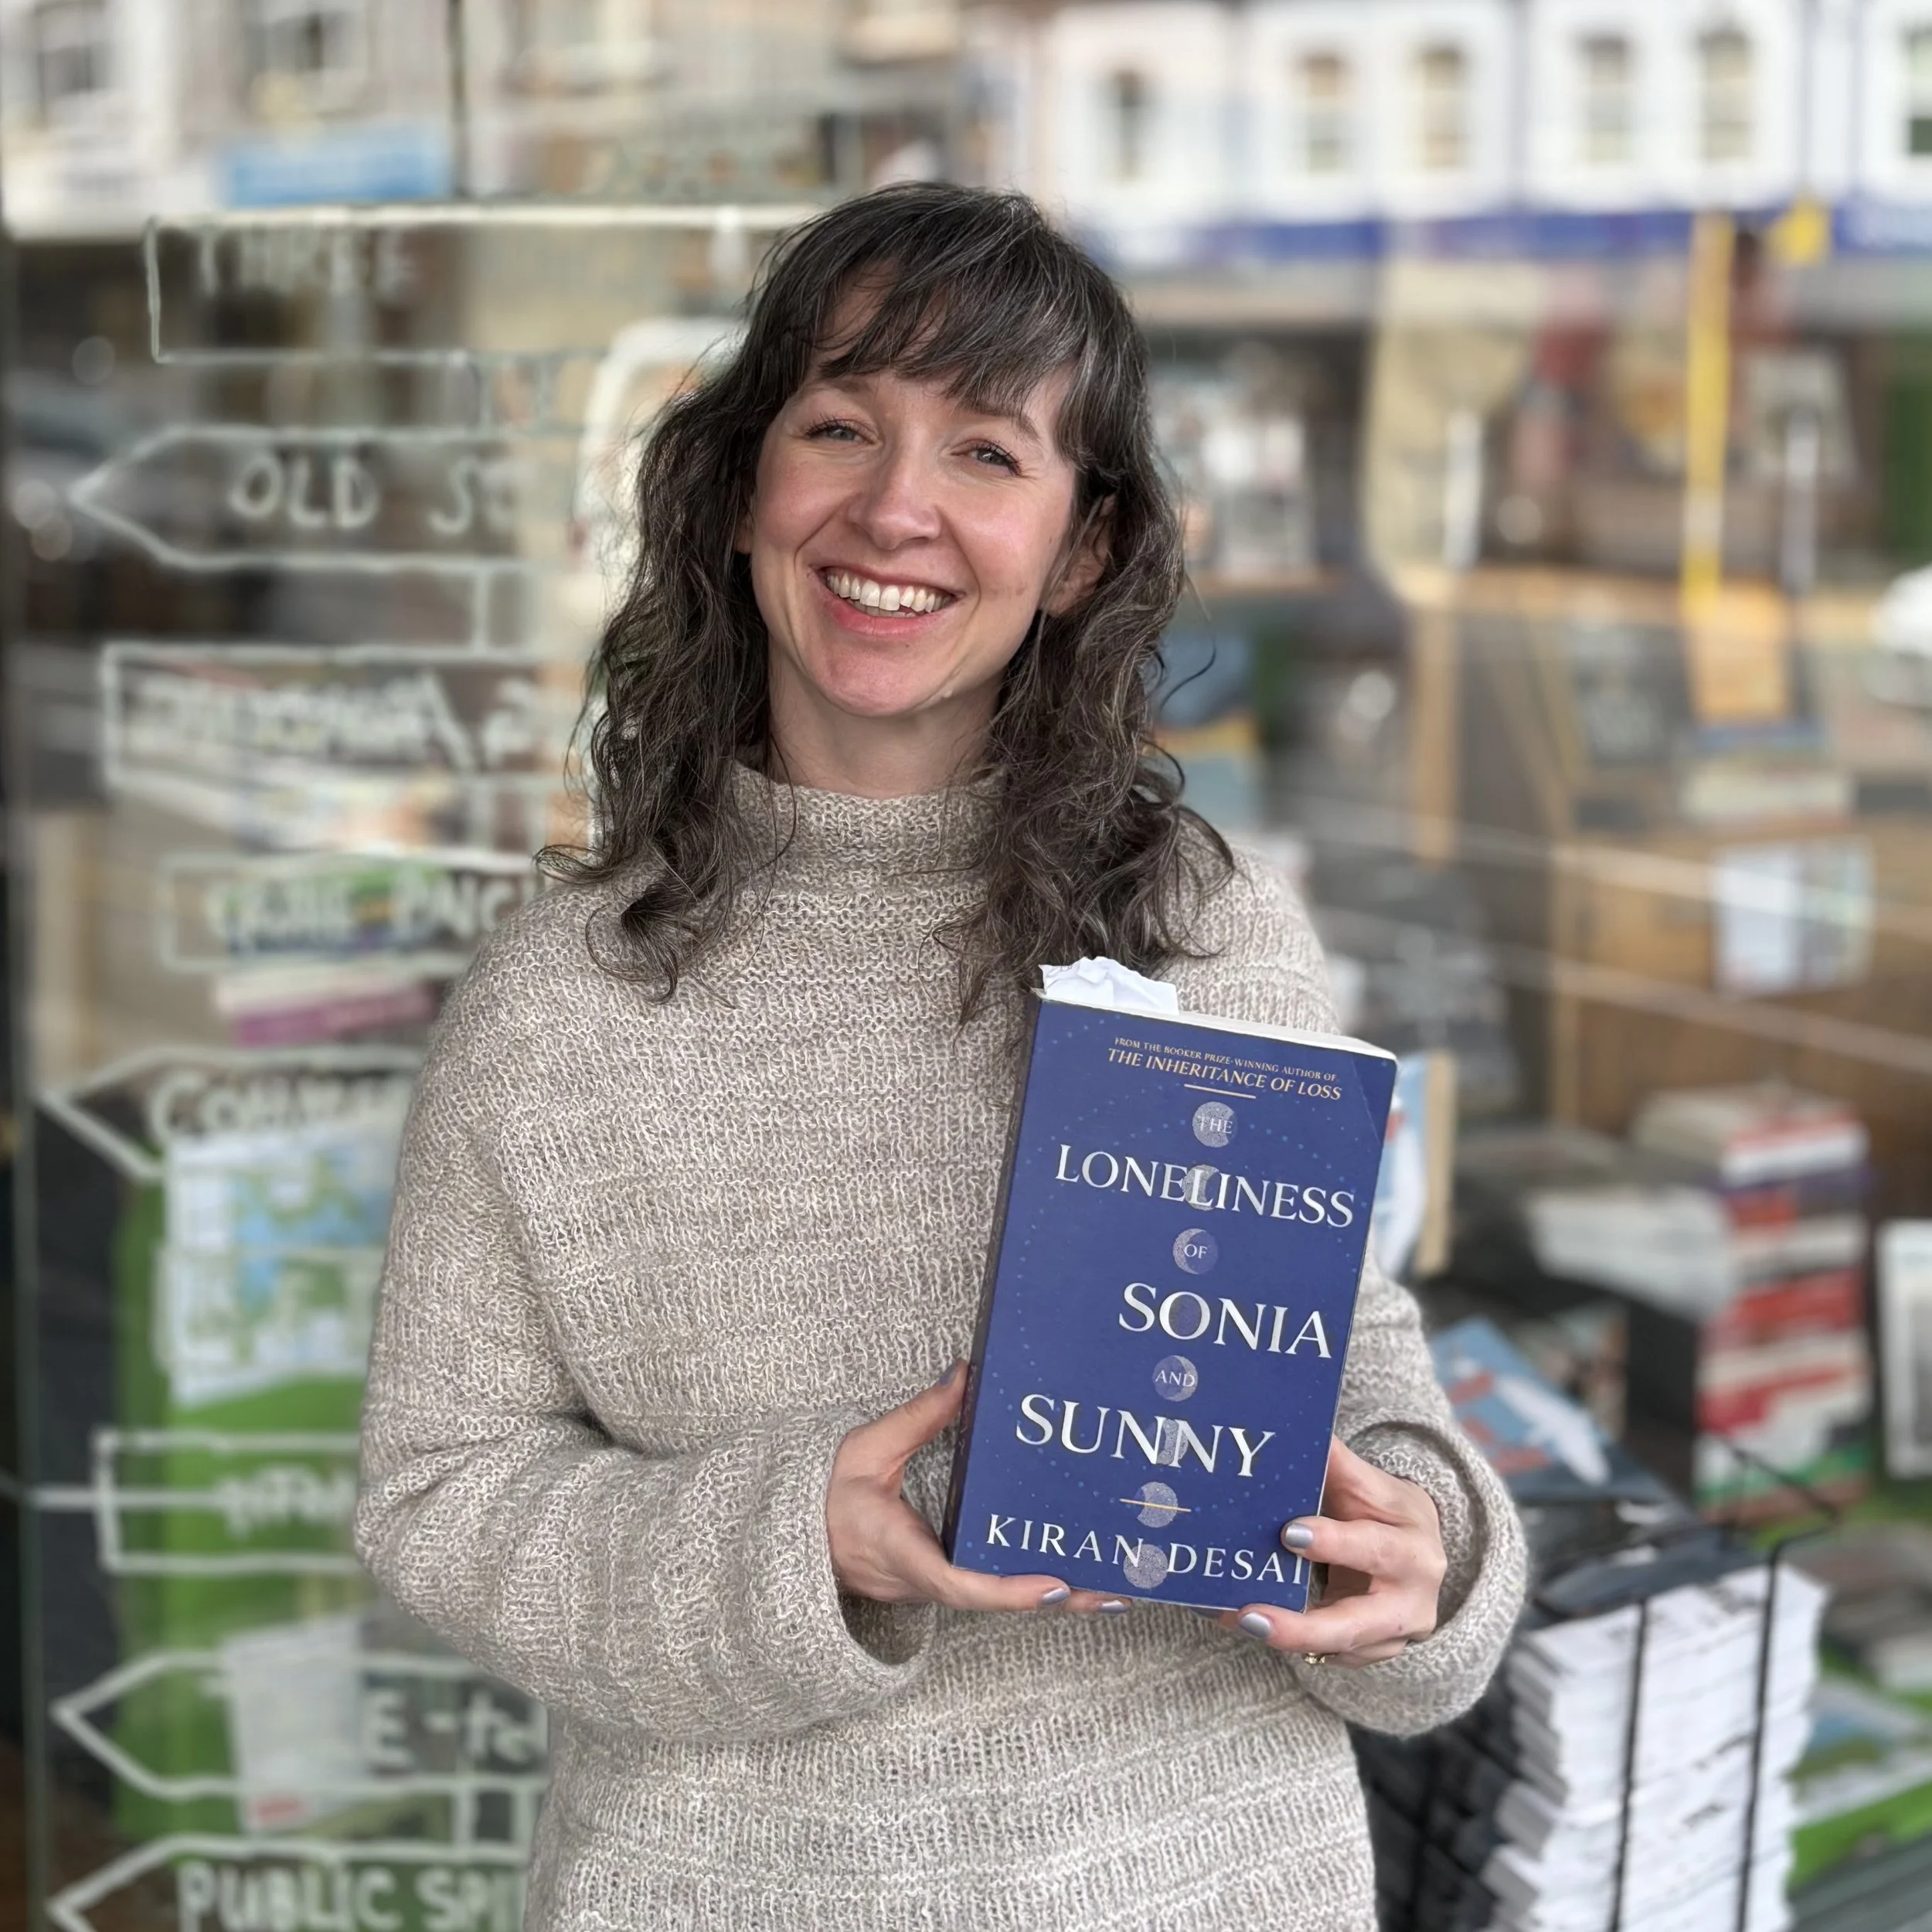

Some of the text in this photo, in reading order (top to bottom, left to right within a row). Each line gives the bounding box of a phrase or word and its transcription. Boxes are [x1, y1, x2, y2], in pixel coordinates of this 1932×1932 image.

[226, 442, 382, 529] OLD
[1108, 1048, 1342, 1100] THE INHERITANCE OF LOSS
[1114, 1037, 1337, 1083] FROM THE BOOKER PRIZE-WINNING AUTHOR OF
[1197, 1116, 1233, 1134] THE
[1056, 1144, 1355, 1229] LONELINESS
[1184, 1243, 1208, 1259] OF
[1118, 1282, 1332, 1359] SONIA
[1155, 1370, 1196, 1387] AND
[1016, 1393, 1276, 1478] SUNNY
[986, 1514, 1304, 1585] KIRAN DESAI
[178, 1859, 403, 1932] PUBLIC
